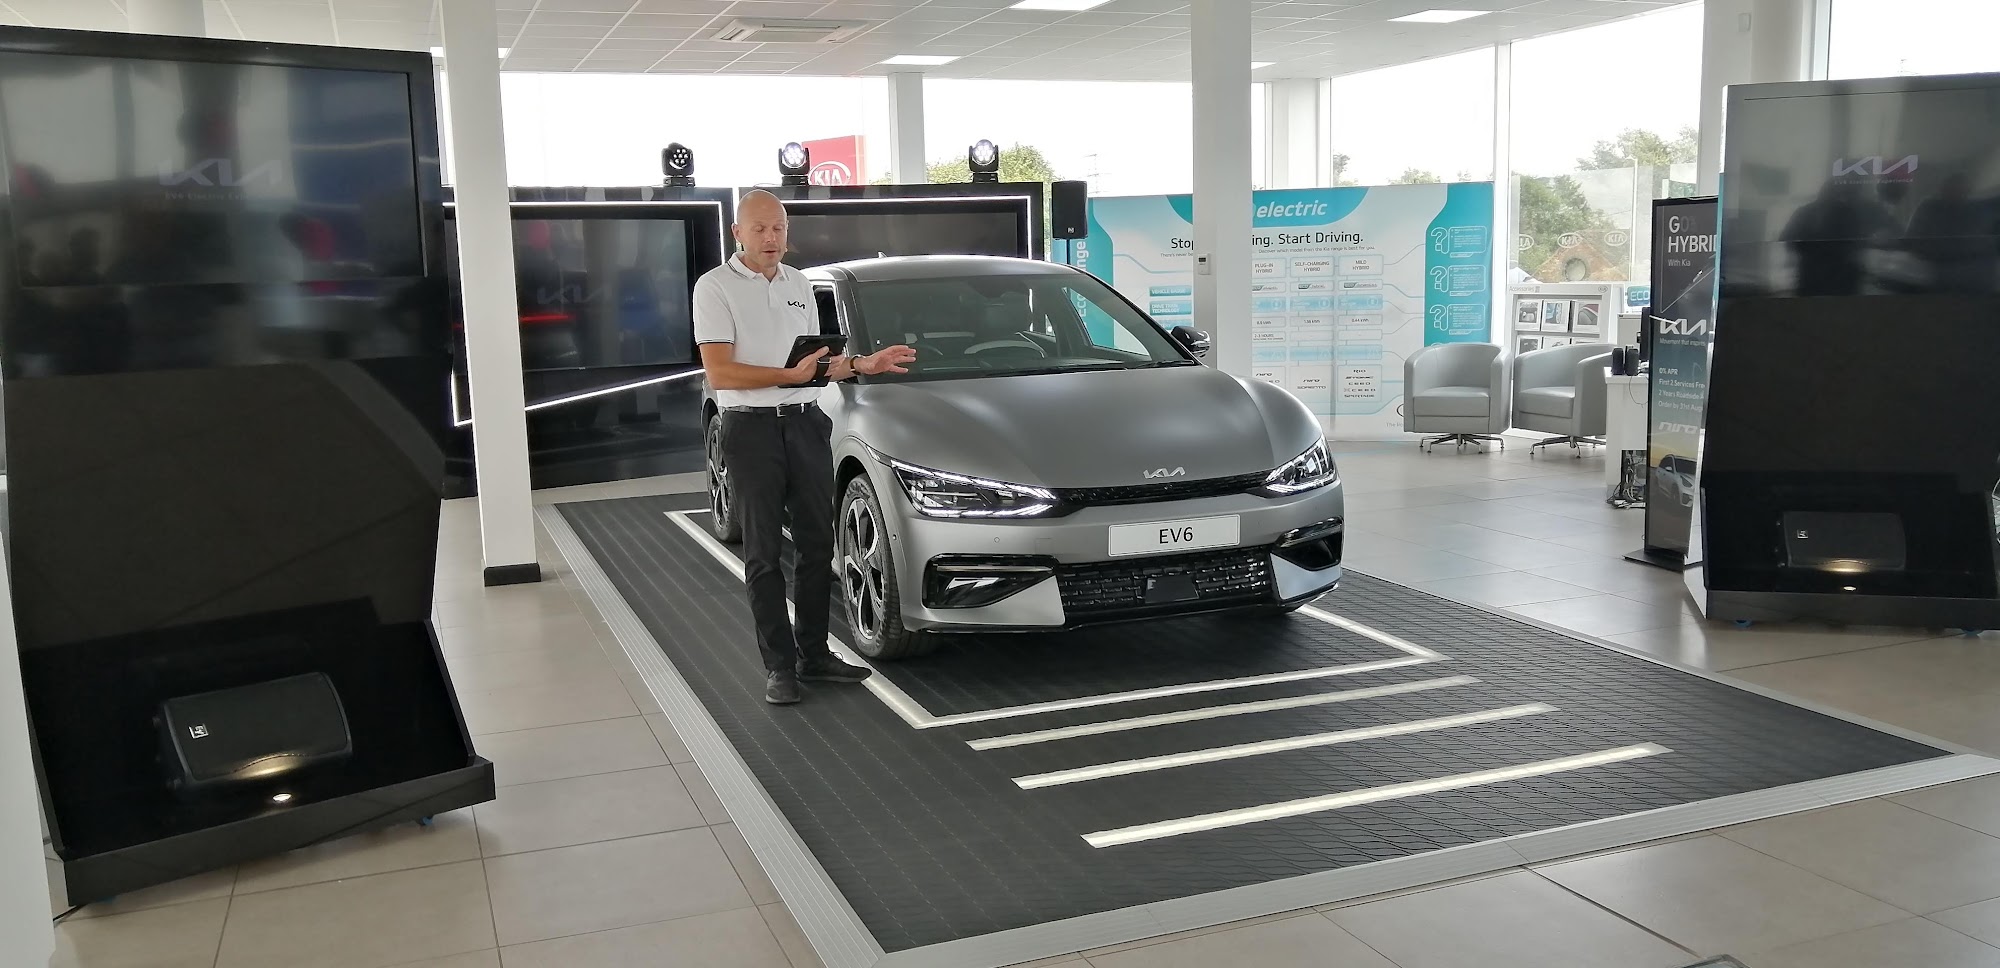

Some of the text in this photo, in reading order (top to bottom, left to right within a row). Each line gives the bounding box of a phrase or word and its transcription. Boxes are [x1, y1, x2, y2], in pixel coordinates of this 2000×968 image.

[1832, 154, 1919, 177] KIA
[158, 157, 283, 187] KIA
[814, 168, 843, 186] KIA
[1256, 200, 1328, 218] electric
[1251, 234, 1274, 248] ing.
[1278, 232, 1311, 245] Start
[1315, 231, 1364, 246] Driving.
[1519, 238, 1531, 248] IA
[1668, 259, 1691, 267] With Kia
[1509, 285, 1535, 293] Accessories
[1630, 290, 1650, 302] ECO
[787, 300, 806, 310] KIA
[1660, 318, 1707, 336] KIA
[1667, 368, 1679, 376] APR
[1658, 378, 1670, 386] First
[1674, 379, 1695, 389] Services
[1662, 390, 1676, 398] Years
[1658, 400, 1673, 408] Order
[1673, 402, 1680, 410] by
[1142, 466, 1186, 479] KIA
[1159, 526, 1194, 544] EV6
